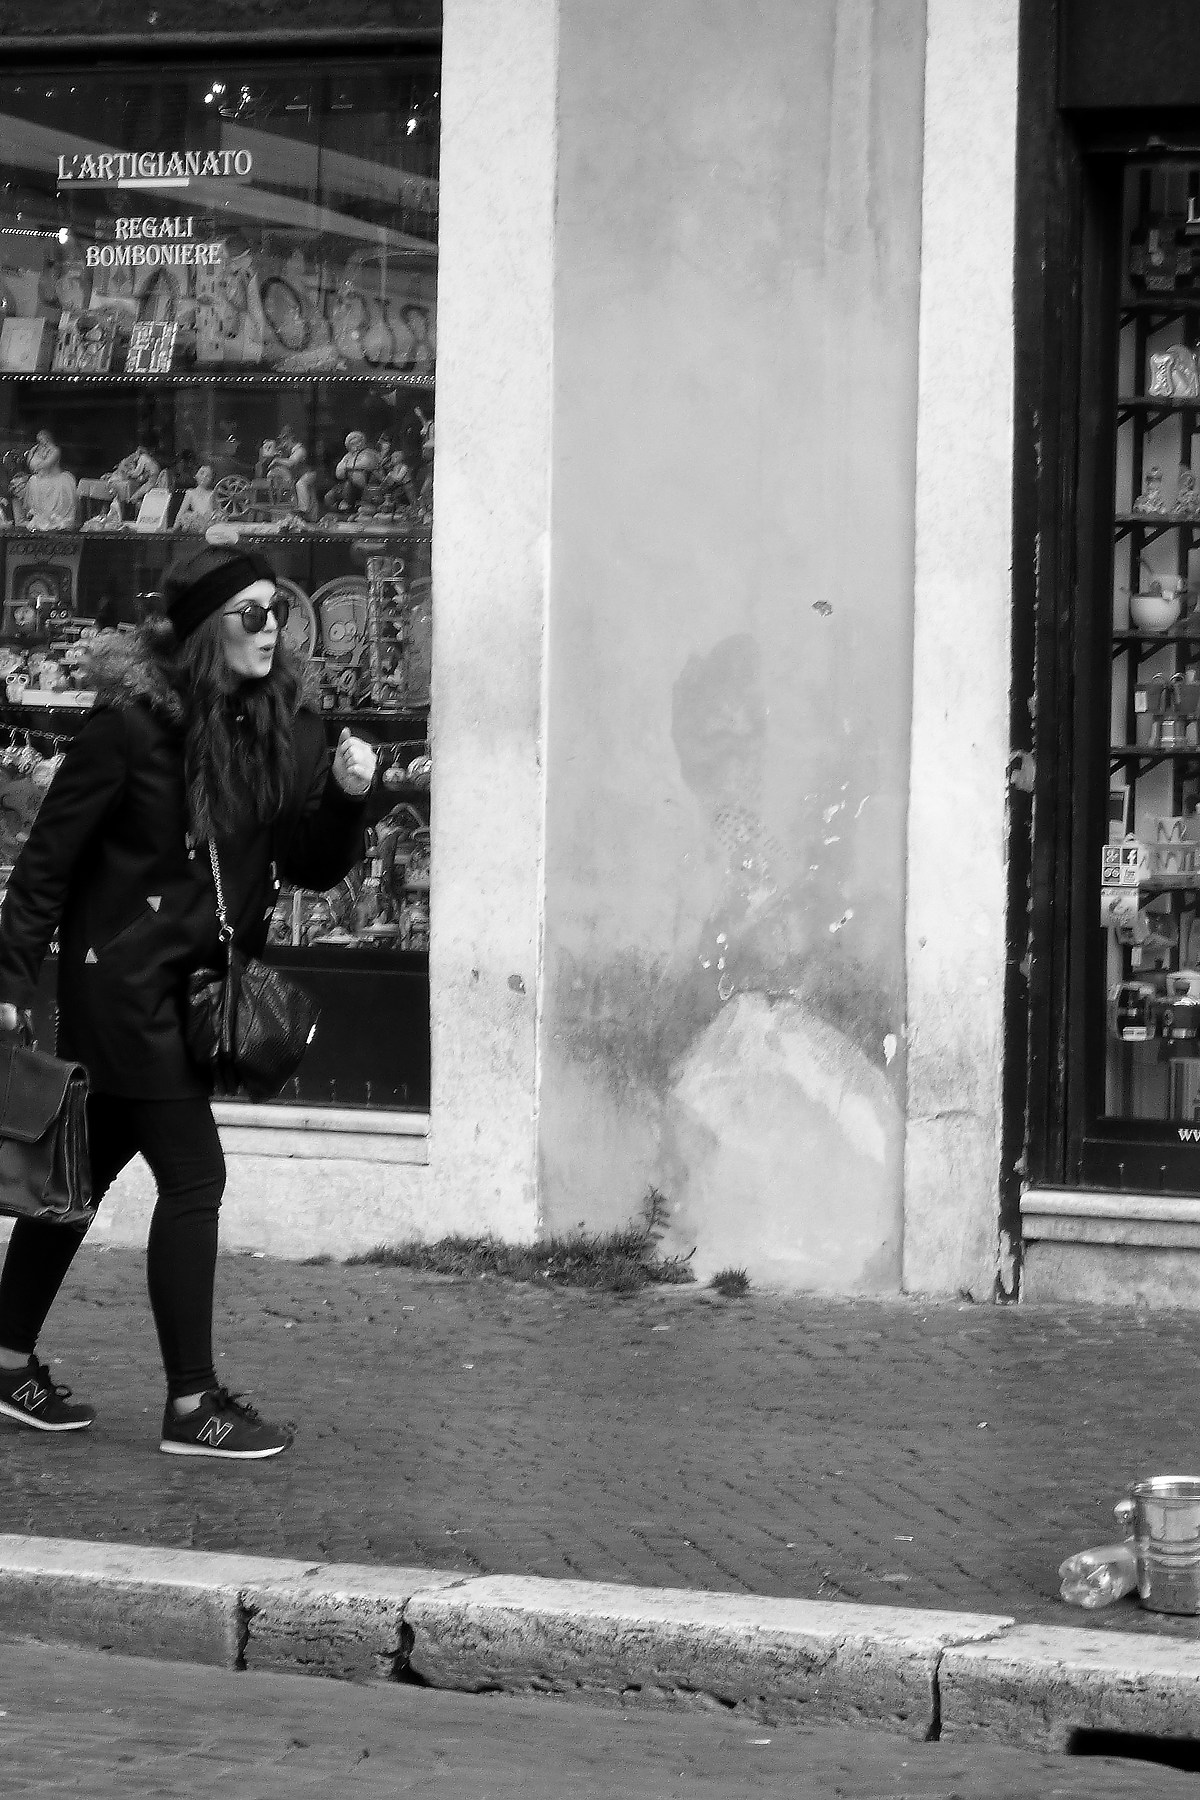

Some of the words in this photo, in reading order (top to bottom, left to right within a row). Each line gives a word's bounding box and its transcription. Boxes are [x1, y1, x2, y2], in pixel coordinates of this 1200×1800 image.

[57, 150, 253, 180] L'ARTIGIANATO
[115, 216, 194, 240] REGALI
[86, 243, 222, 267] BOMBONIERE
[11, 1378, 50, 1411] N
[196, 1416, 234, 1446] N
